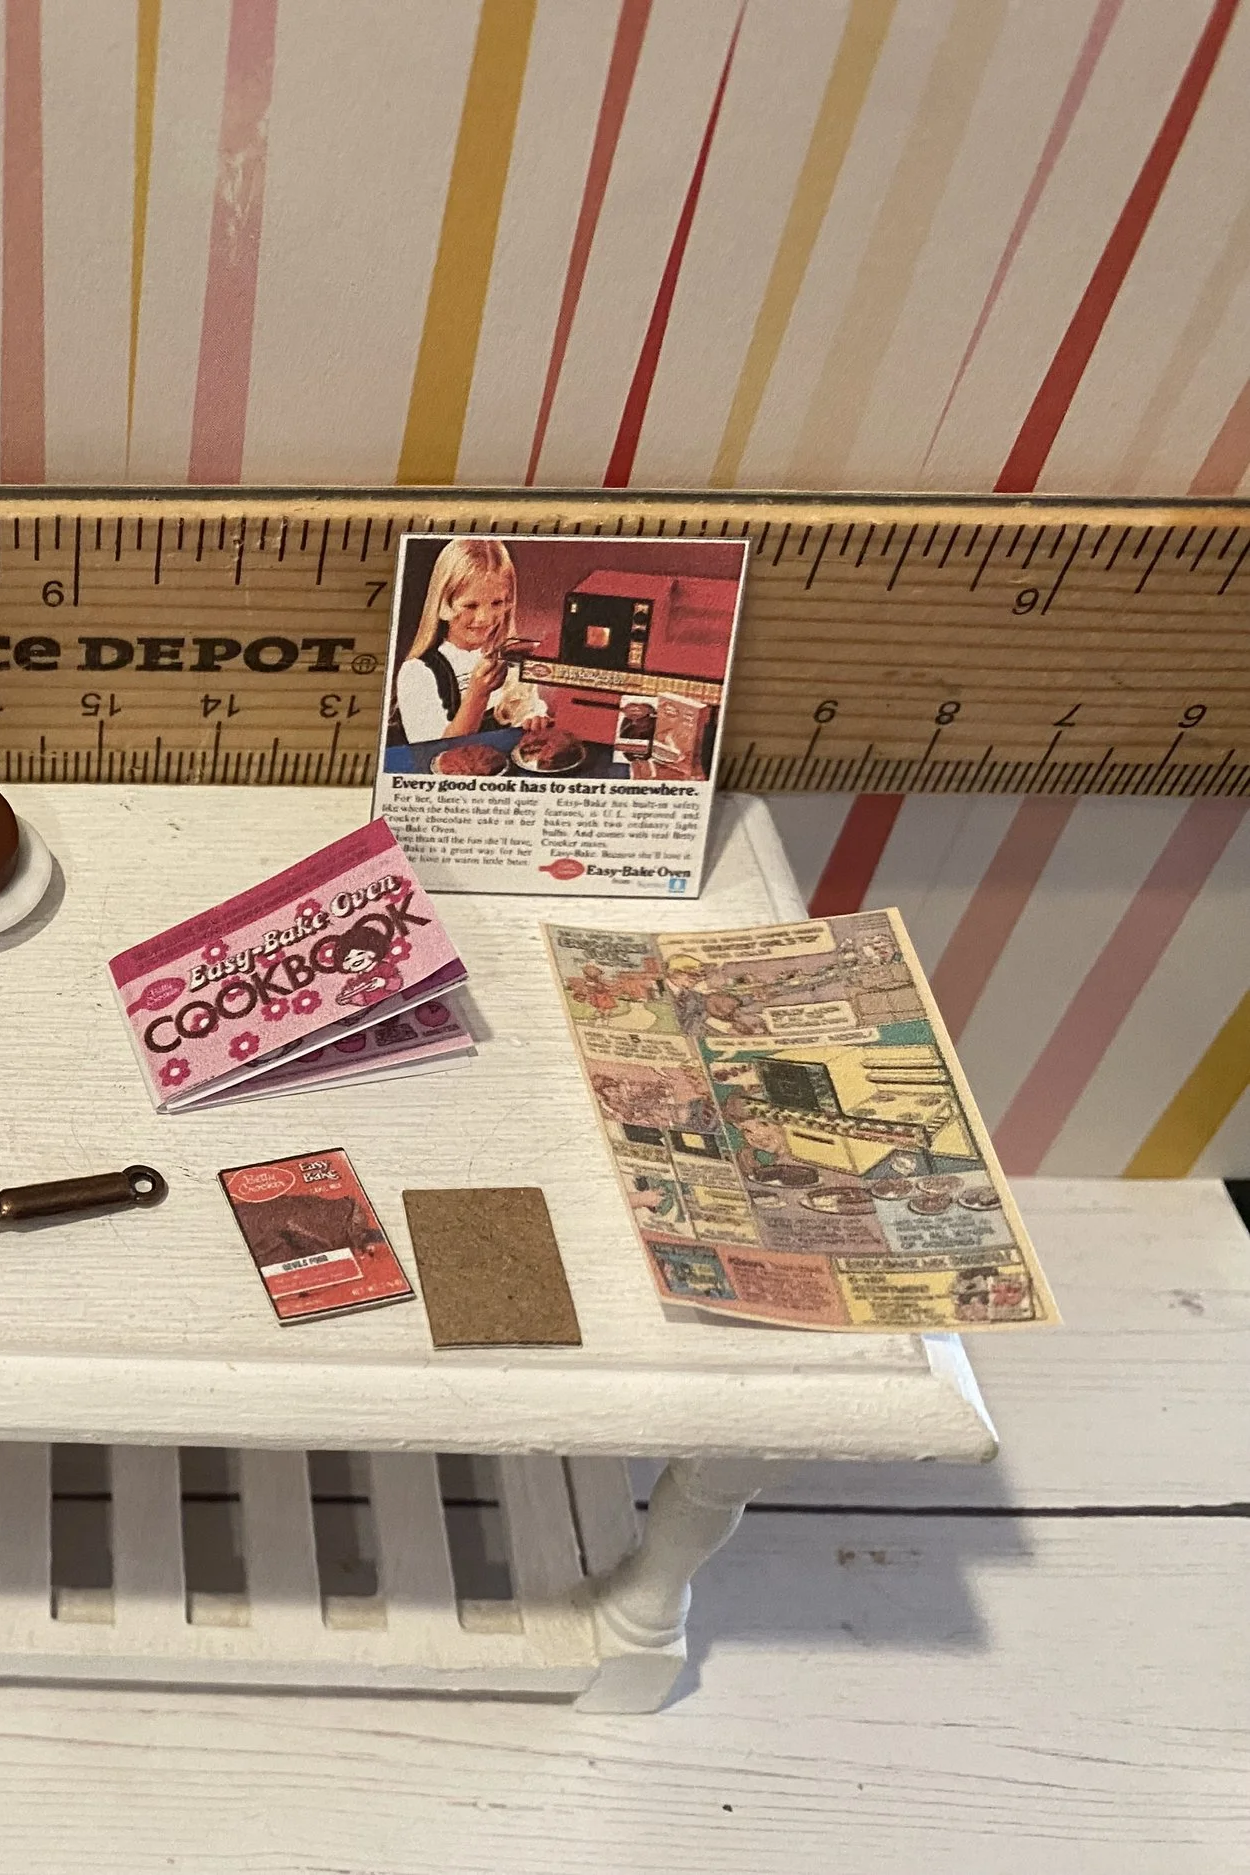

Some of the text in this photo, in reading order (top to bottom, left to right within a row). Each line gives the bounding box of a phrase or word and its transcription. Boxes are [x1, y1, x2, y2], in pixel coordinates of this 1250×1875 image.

[41, 579, 65, 607] 6
[364, 581, 388, 608] 7
[1011, 587, 1040, 616] 9
[77, 635, 356, 673] DEPOT
[392, 775, 700, 797] Every good cook has to start somewhere.
[400, 804, 425, 813] when
[427, 805, 442, 813] she
[444, 805, 470, 815] bakes
[472, 806, 490, 815] that
[425, 815, 472, 825] chocolate
[477, 816, 500, 826] cake
[543, 818, 572, 828] bakes
[415, 835, 436, 844] than
[451, 836, 465, 844] the
[573, 829, 594, 838] And
[586, 864, 656, 877] Easy-Bake
[657, 866, 692, 878] Oven
[187, 873, 403, 992] Easy-Bake Oven
[144, 890, 434, 1054] COOKBOOK
[298, 1159, 331, 1173] Easy
[302, 1169, 341, 1184] Bake
